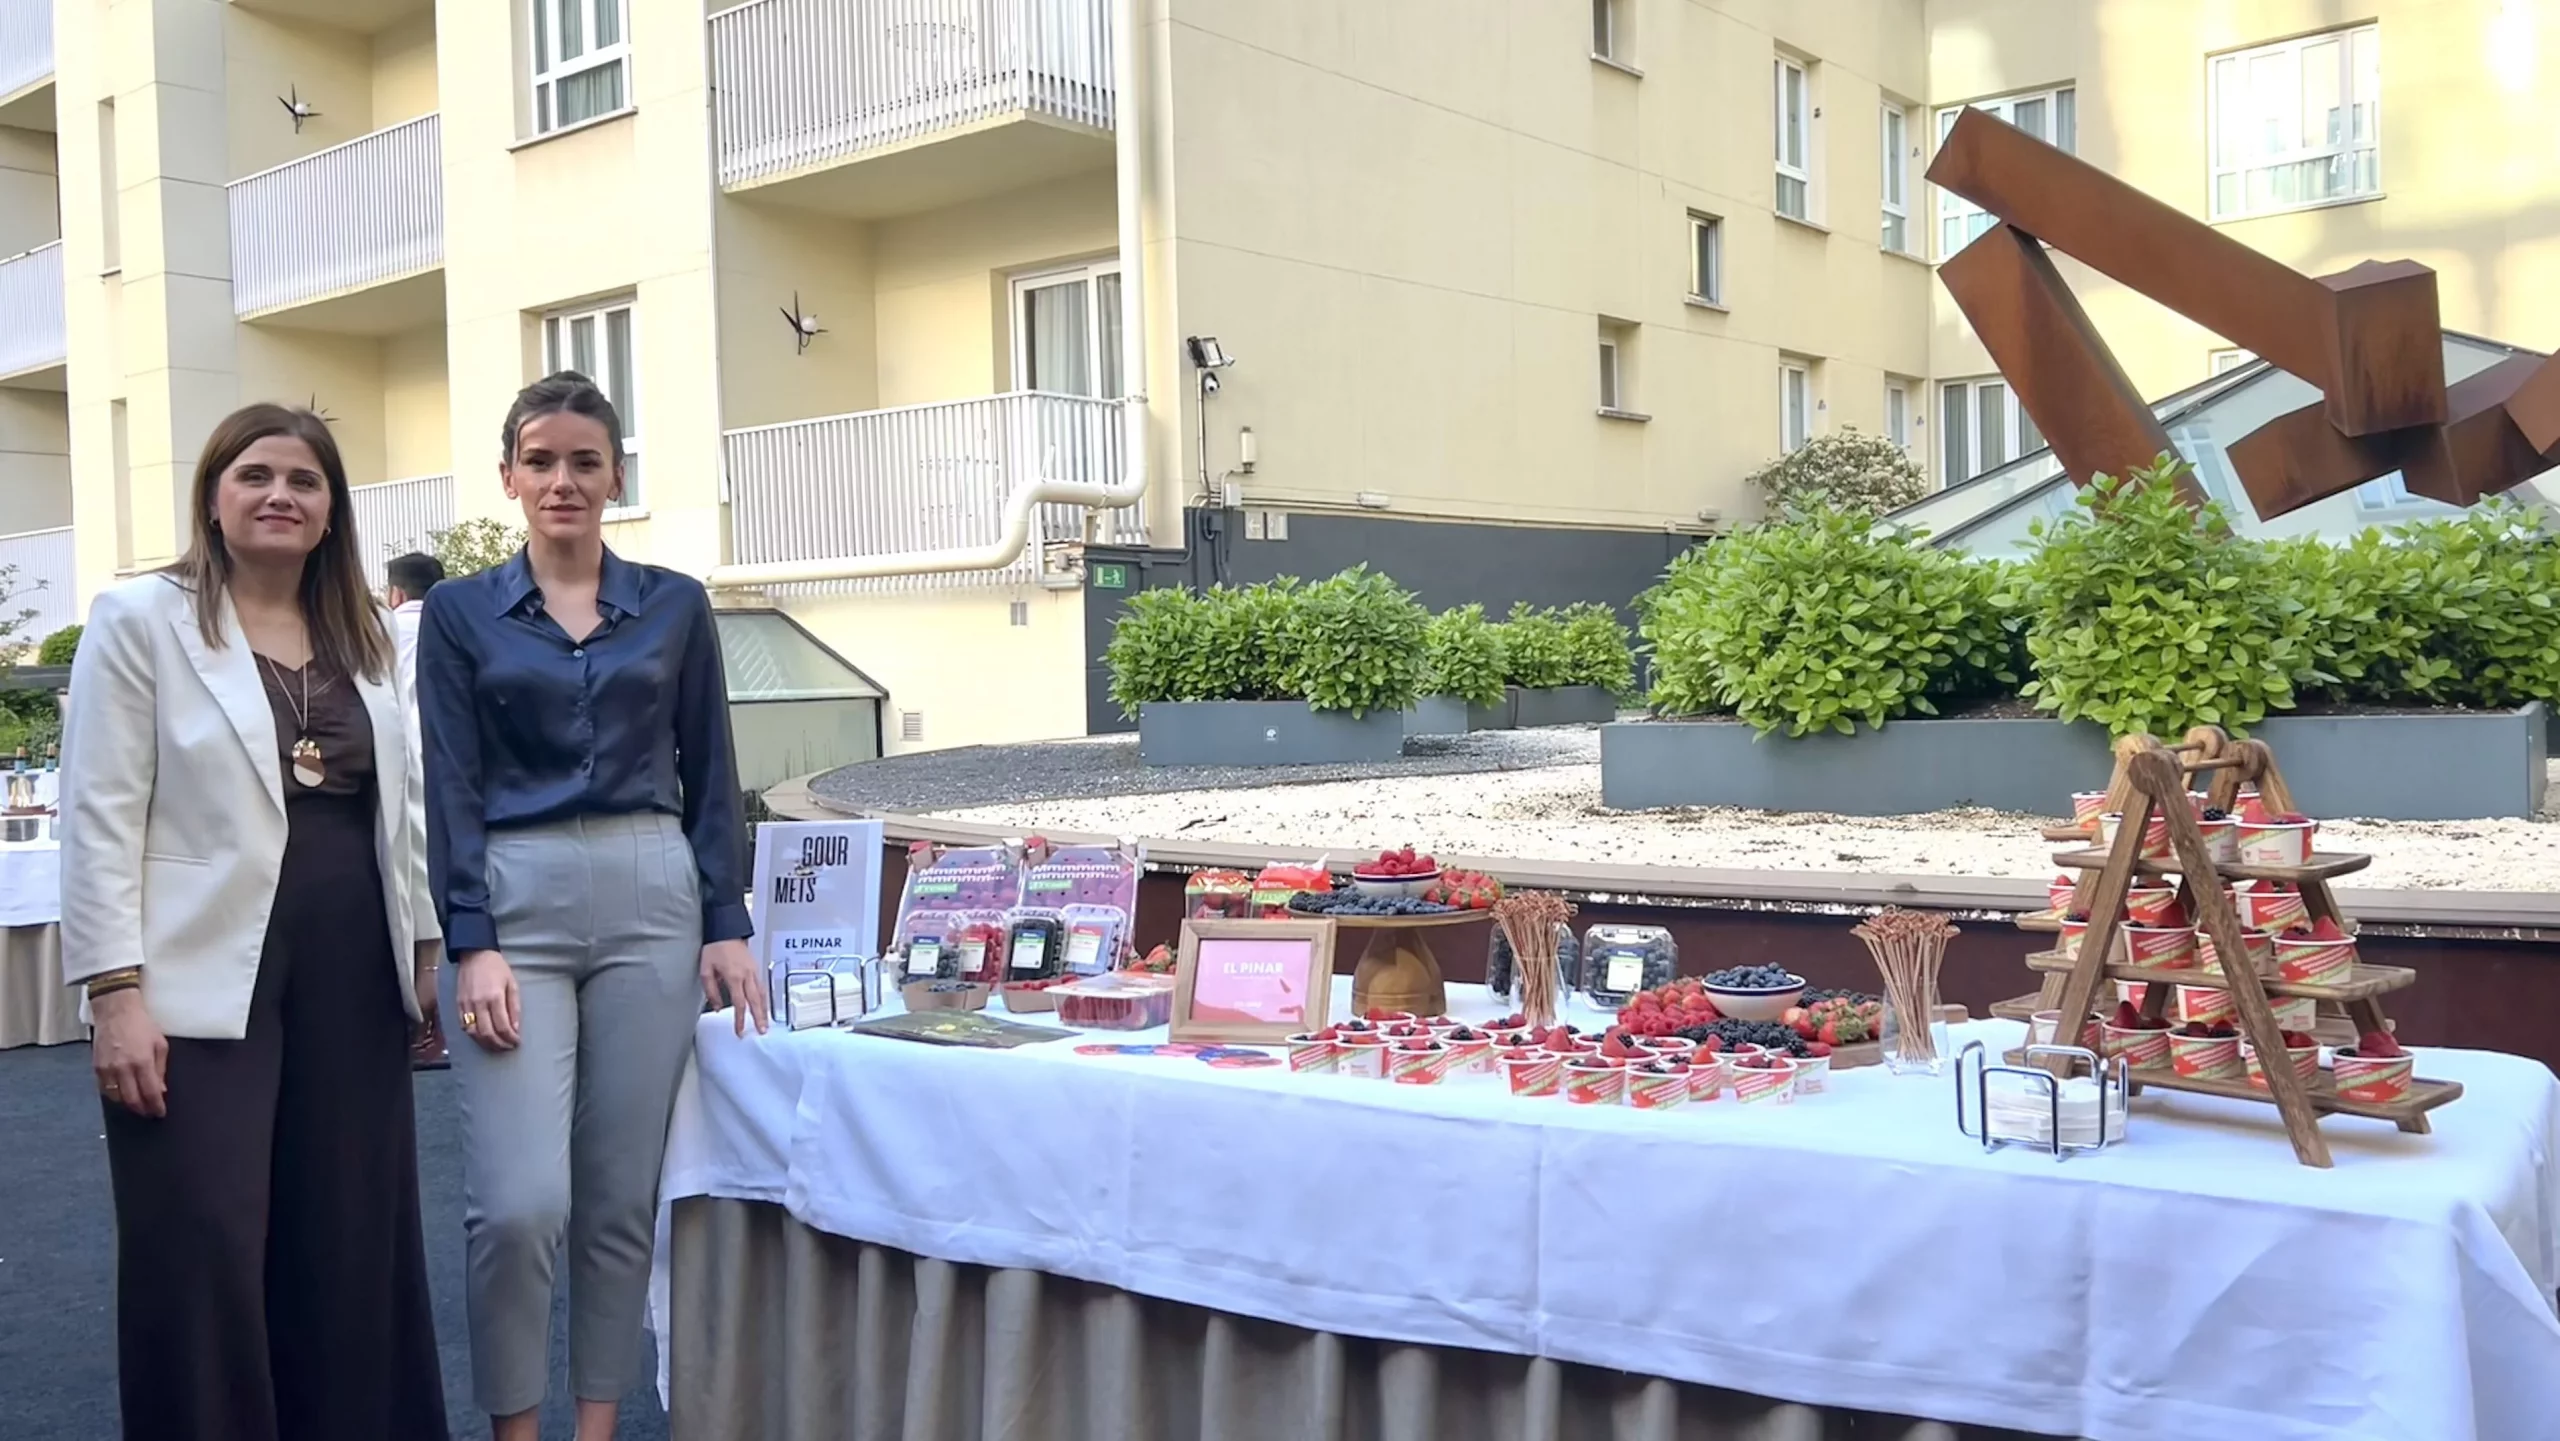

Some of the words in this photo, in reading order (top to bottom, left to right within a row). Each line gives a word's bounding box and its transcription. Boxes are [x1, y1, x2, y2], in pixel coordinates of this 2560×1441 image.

[802, 836, 849, 867] GOUR
[774, 876, 816, 904] METS
[785, 938, 798, 949] EL
[801, 937, 842, 949] PINAR
[1223, 962, 1237, 974] EL
[1240, 962, 1283, 974] PINAR
